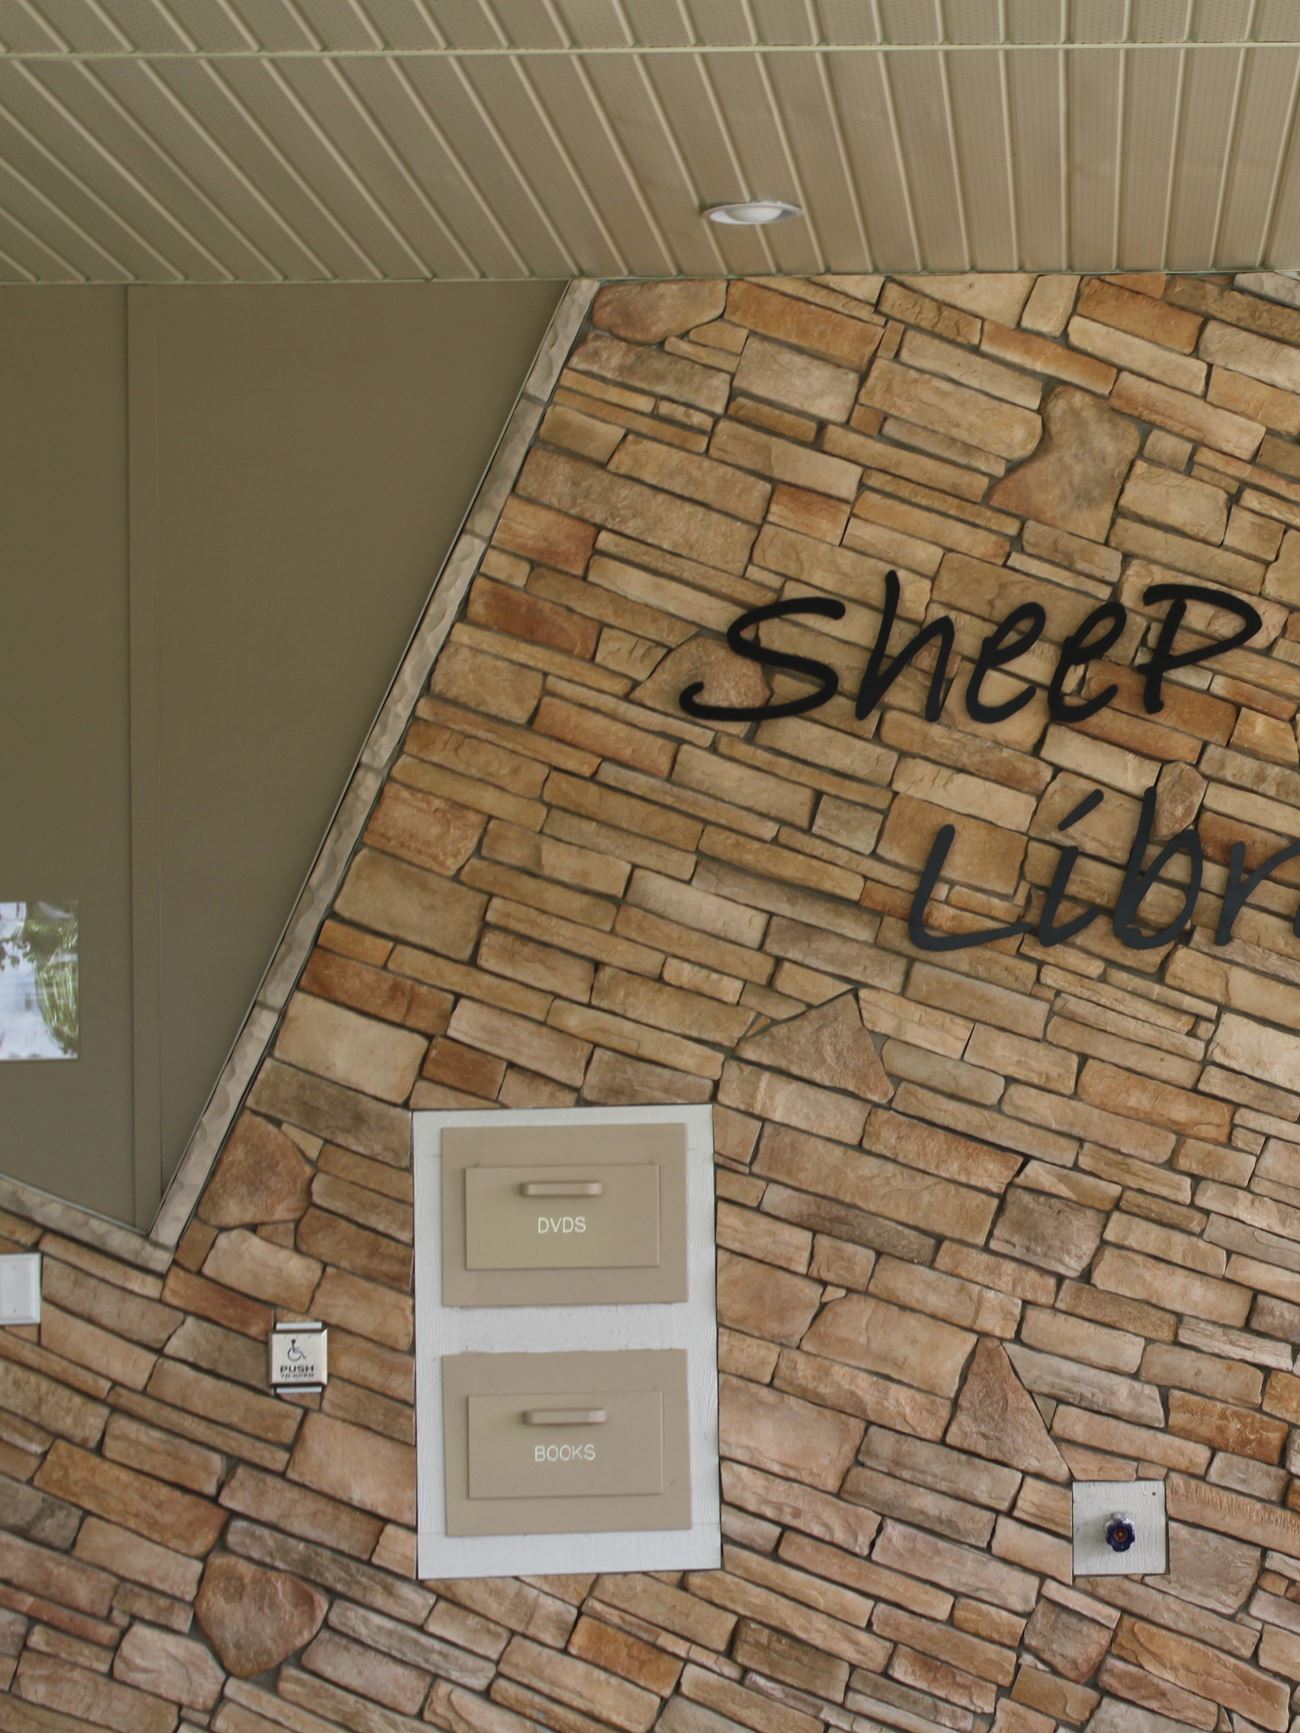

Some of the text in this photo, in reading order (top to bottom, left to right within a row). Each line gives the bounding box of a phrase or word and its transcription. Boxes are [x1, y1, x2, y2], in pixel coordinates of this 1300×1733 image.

[537, 1216, 587, 1234] DVDS
[280, 1365, 315, 1373] PUSH
[534, 1444, 596, 1462] BOOKS
